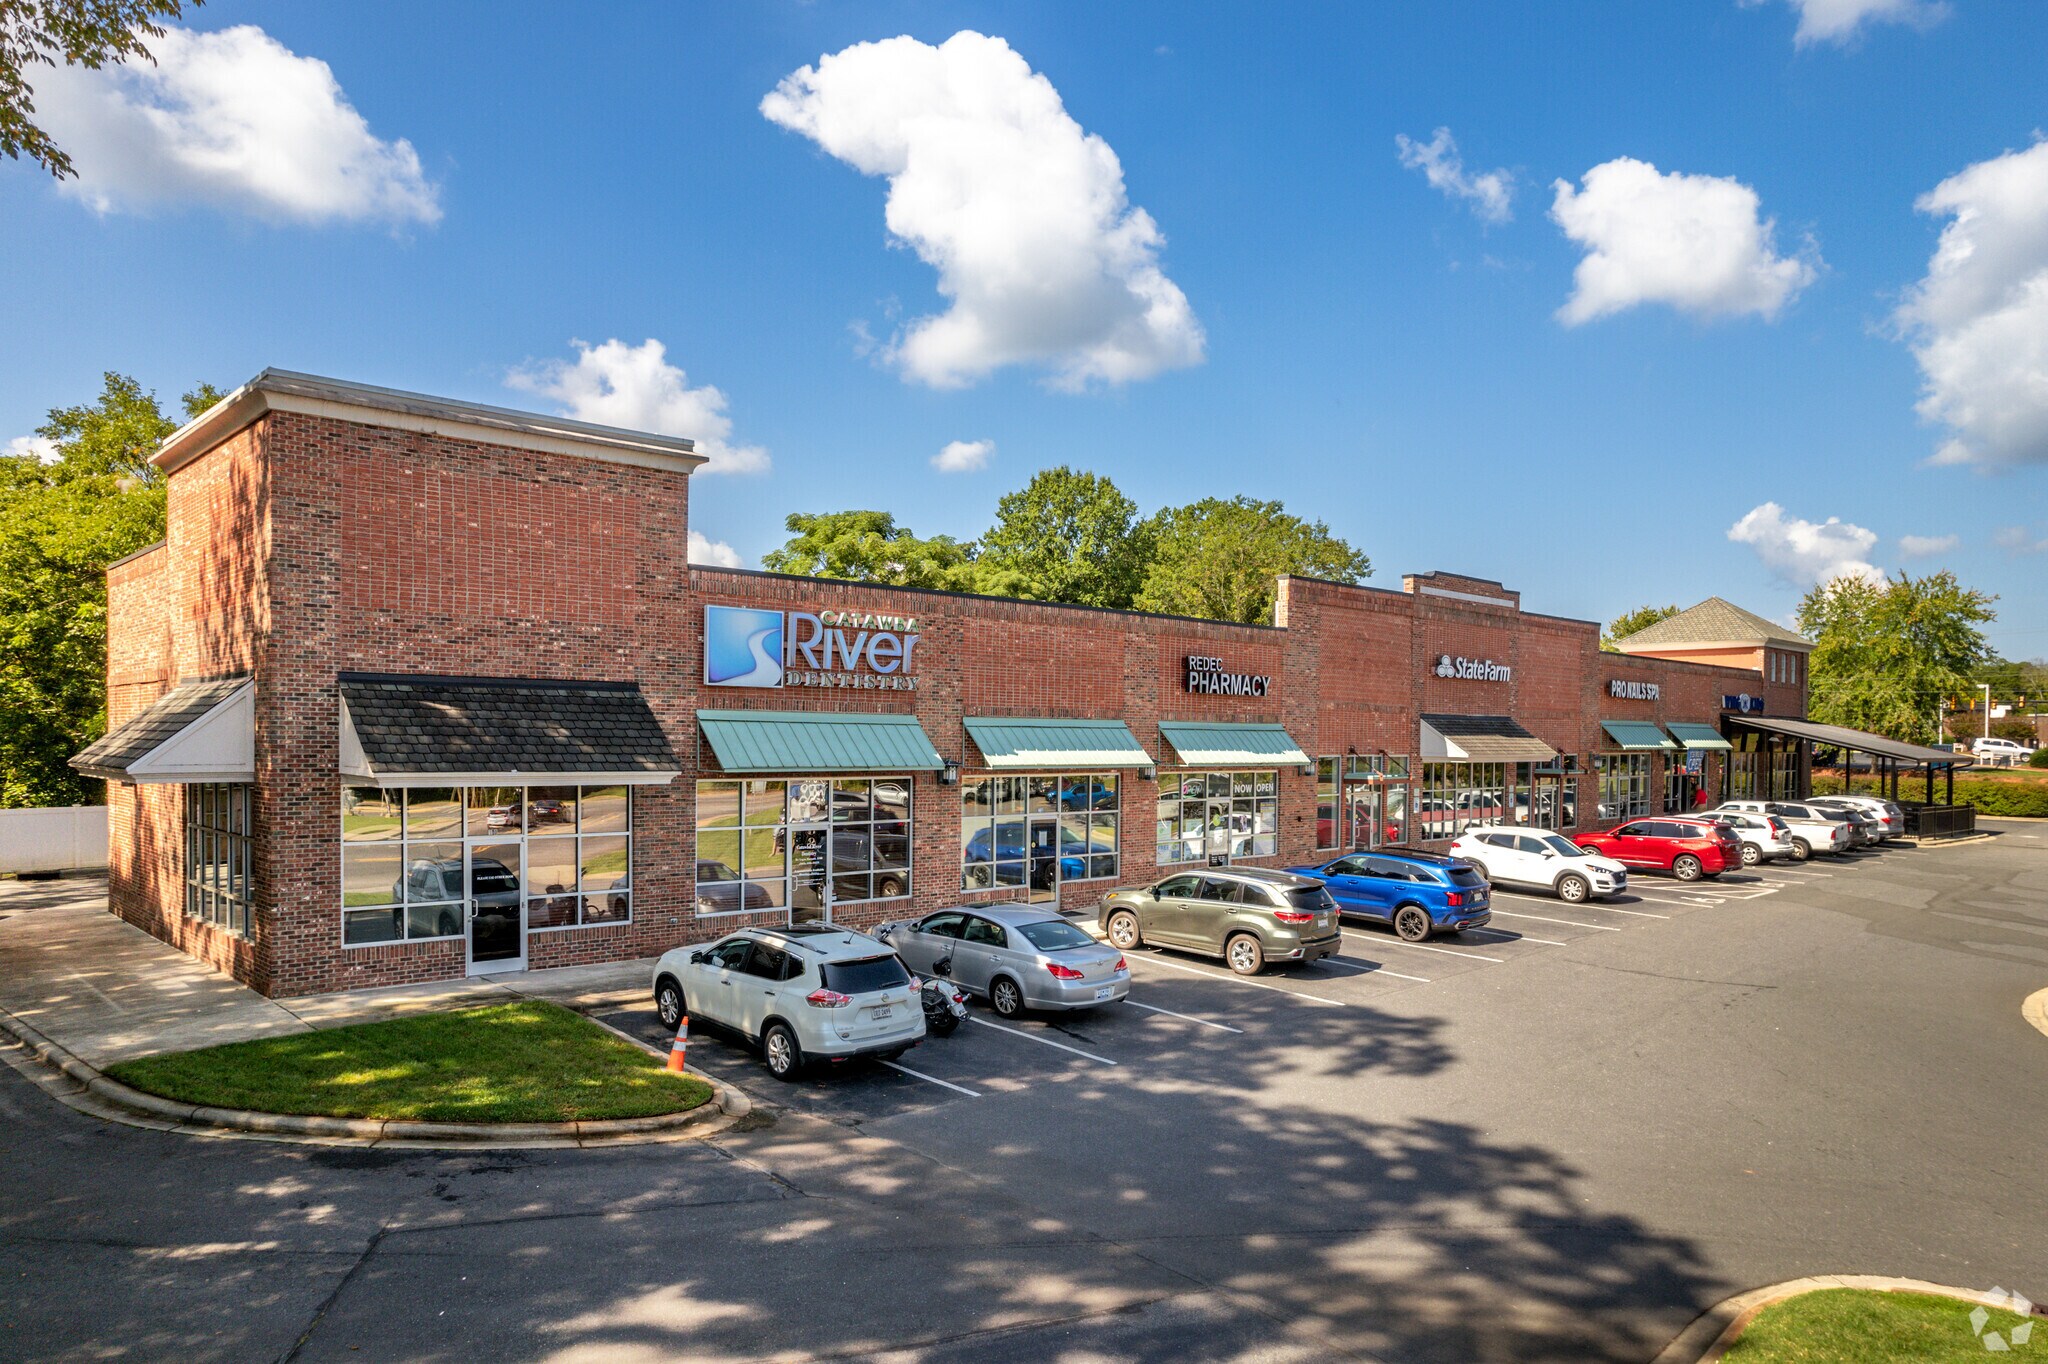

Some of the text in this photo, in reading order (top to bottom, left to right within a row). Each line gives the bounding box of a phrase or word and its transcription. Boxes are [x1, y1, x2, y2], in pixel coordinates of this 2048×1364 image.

[820, 610, 919, 632] CATAWBA
[786, 611, 921, 674] River
[1189, 655, 1223, 672] REDEC
[786, 671, 920, 691] DENTISTRY
[1189, 671, 1271, 697] PHARMACY
[1611, 679, 1660, 701] PRO NAILS SPA
[1182, 784, 1201, 795] OPEN
[1234, 783, 1274, 793] NOW OPEN
